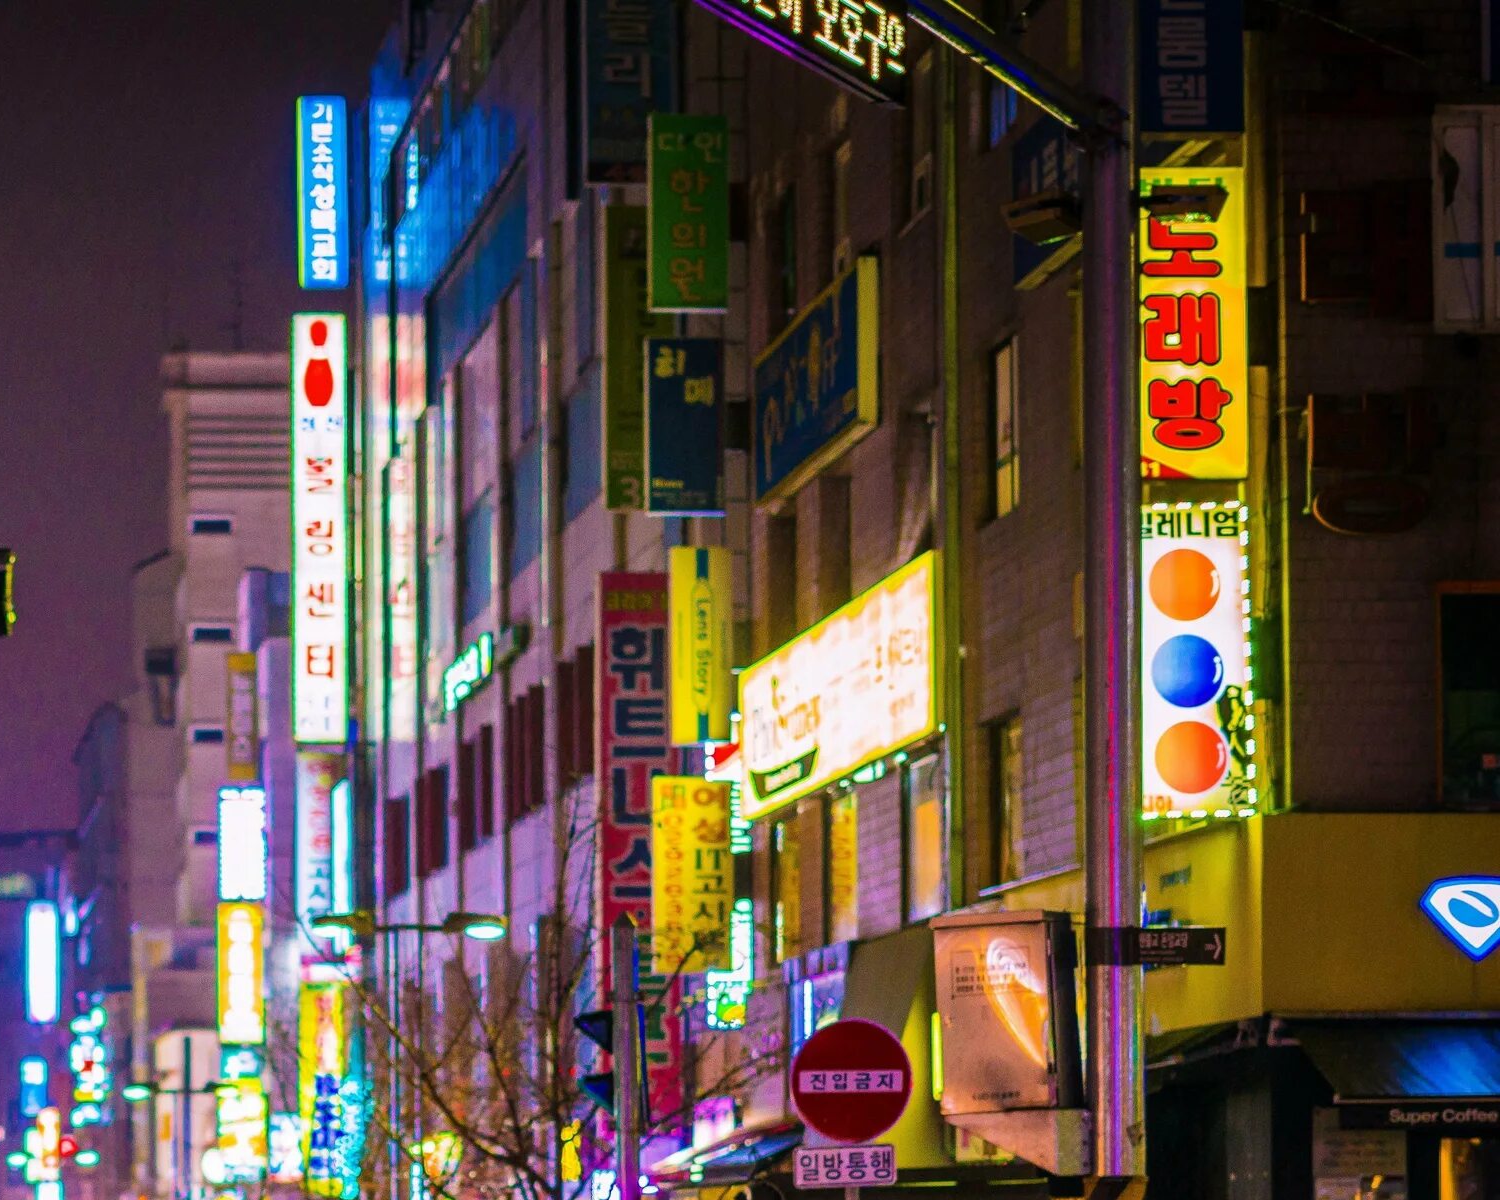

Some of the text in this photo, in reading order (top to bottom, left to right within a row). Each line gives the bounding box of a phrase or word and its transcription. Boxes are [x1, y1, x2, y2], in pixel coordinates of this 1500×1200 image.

[1141, 220, 1232, 450] 노래방
[809, 1071, 895, 1091] 진입금지
[1388, 1106, 1499, 1126] Super Coffee
[799, 1150, 892, 1182] 일방통행
